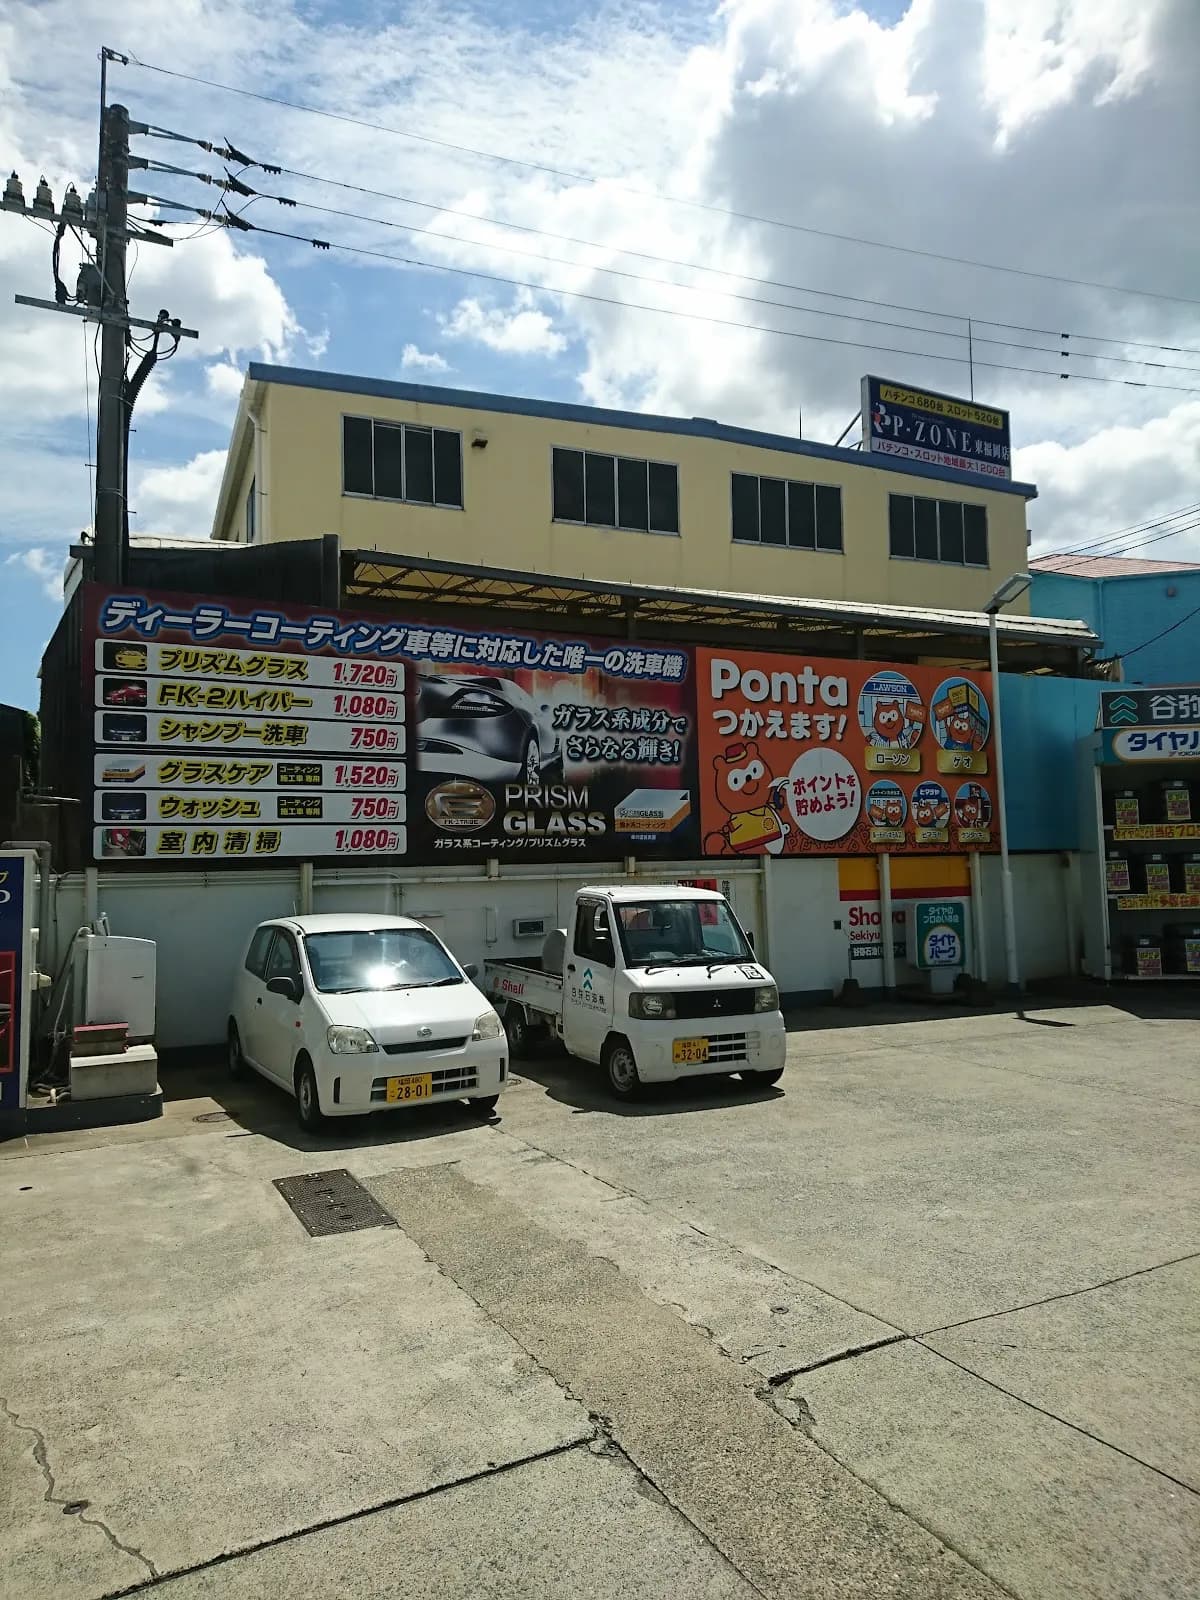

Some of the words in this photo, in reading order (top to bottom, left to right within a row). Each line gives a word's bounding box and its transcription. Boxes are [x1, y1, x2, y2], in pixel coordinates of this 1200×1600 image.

[102, 599, 686, 682] ディーラーコーティング車等に対応した唯一の洗車機
[159, 648, 310, 681] プリズムグラス
[709, 657, 849, 708] Ponta
[872, 682, 908, 693] LAWSON
[158, 683, 314, 712] FK-2ハイパー
[552, 705, 689, 734] ガラス系成分で
[712, 709, 847, 742] つかえます!
[159, 719, 310, 745] シャンプー洗車
[280, 766, 321, 774] コーティング
[876, 753, 911, 766] ローソン
[952, 755, 972, 769] ゲオ
[159, 760, 274, 784] グラスケア
[504, 783, 590, 809] PRISM
[792, 772, 856, 797] ポイントを
[159, 795, 261, 819] ウォッシュ
[280, 799, 321, 807] コーティング
[795, 790, 856, 816] 貯めよう!
[502, 810, 607, 836] GLASS
[433, 838, 587, 849] ガラス系コーティング/プリズムグラス
[929, 934, 955, 947] タイヤ
[929, 946, 956, 959] パーク
[502, 979, 525, 995] Shell
